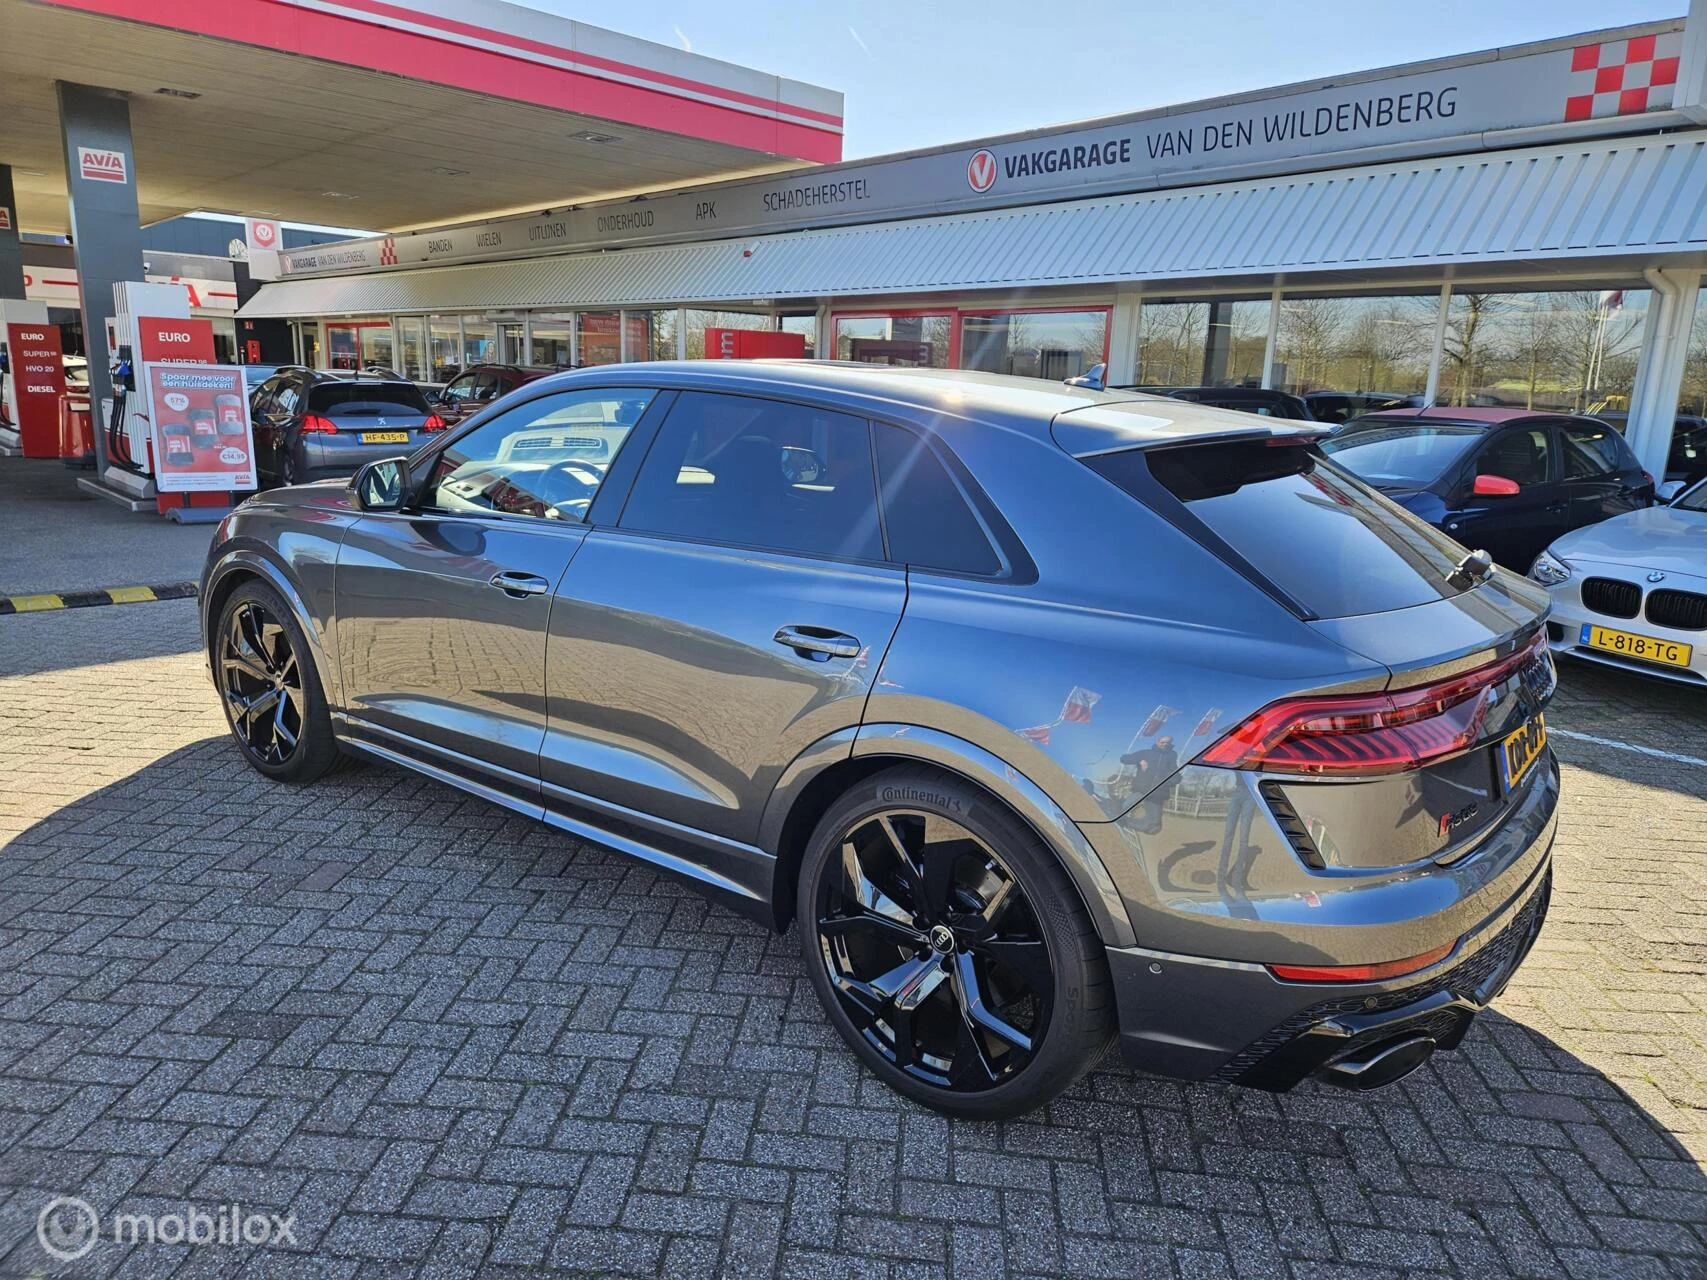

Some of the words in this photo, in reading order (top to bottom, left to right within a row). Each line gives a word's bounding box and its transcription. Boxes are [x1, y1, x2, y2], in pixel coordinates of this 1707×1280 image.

[1004, 138, 1131, 178] VAKGARAGE
[1147, 128, 1192, 159] VAN
[1203, 119, 1253, 152] DEN
[1263, 87, 1458, 143] WILDENBERG
[763, 178, 871, 212] SCHADEHERSTEL
[695, 201, 717, 220] APK
[597, 210, 655, 233] ONDERHOUD
[528, 221, 567, 241] UITLIJNEN
[428, 238, 453, 254] BANDEN
[475, 231, 502, 248] WIELEN
[21, 332, 45, 341] EURO
[158, 332, 191, 343] EURO
[23, 350, 50, 358] SUPER
[25, 365, 44, 373] HVO
[44, 365, 55, 373] 20
[161, 373, 190, 382] Spaar
[191, 374, 213, 382] mee
[213, 375, 235, 383] voor
[162, 380, 180, 388] een
[27, 385, 56, 393] DIESEL
[365, 433, 405, 441] HF-435-P
[1598, 630, 1678, 661] L-818-TG
[882, 786, 952, 810] Continental
